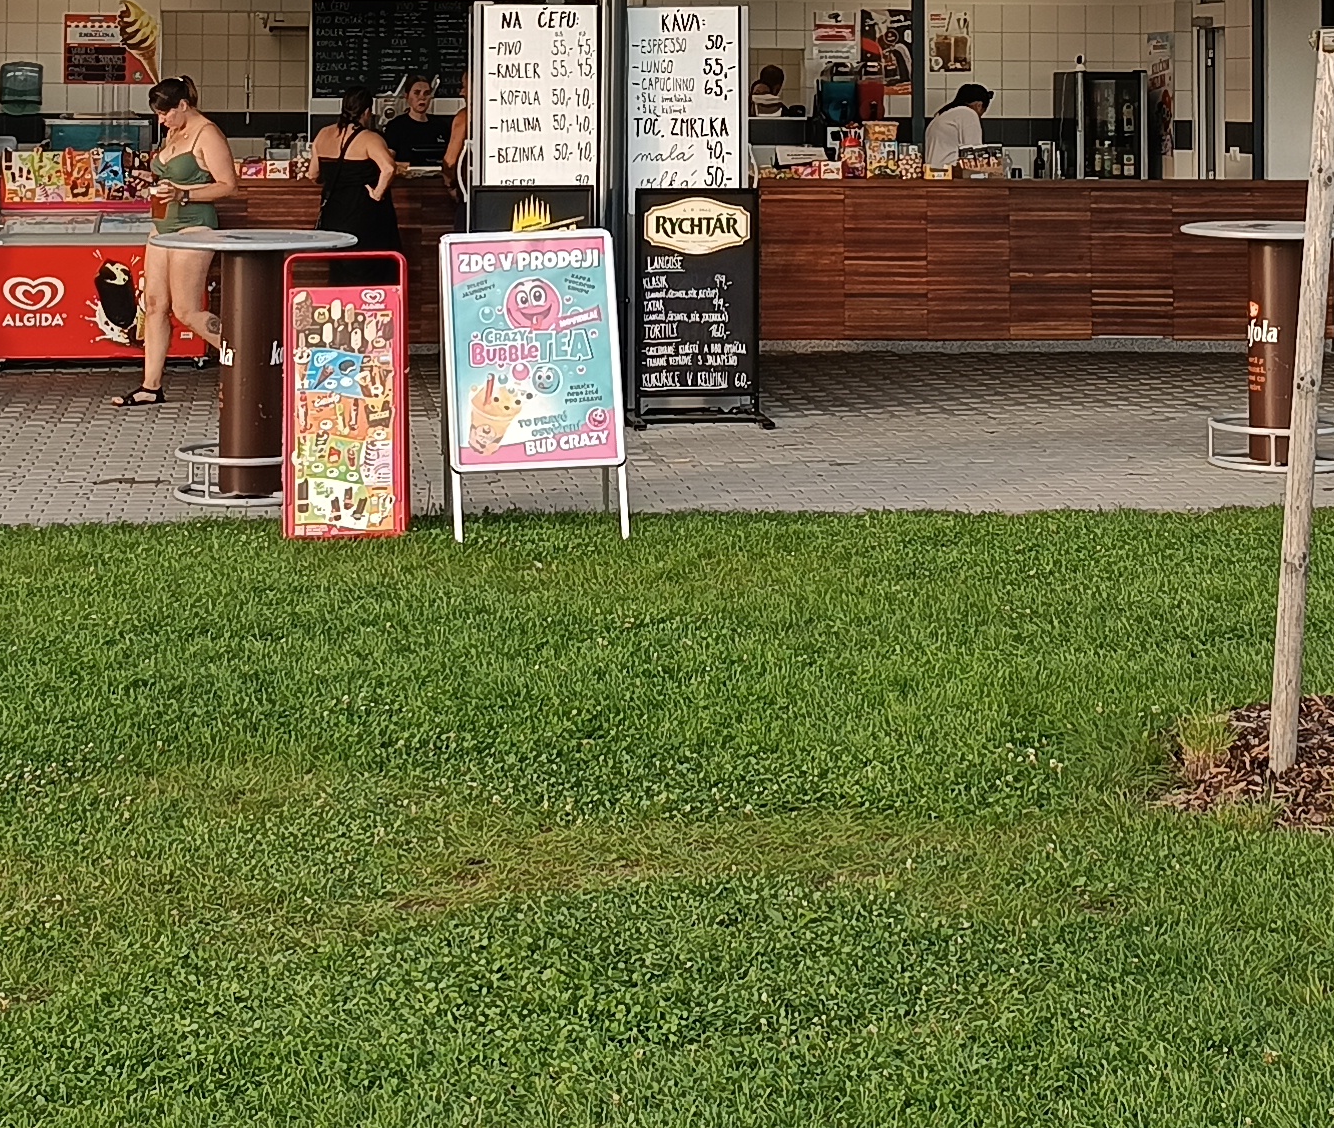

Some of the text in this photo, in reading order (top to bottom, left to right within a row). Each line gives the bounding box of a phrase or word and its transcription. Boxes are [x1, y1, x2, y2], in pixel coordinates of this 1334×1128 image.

[501, 7, 579, 29] NA ČEPU:
[661, 9, 706, 33] KÁVA:
[705, 34, 734, 52] 50,-
[703, 58, 736, 79] 55,-
[704, 79, 734, 101] 65,-
[670, 117, 729, 138] ZMRZKA
[632, 139, 732, 163] malá 40,-
[655, 213, 744, 239] RYCHTÁŘ
[498, 252, 514, 271] V
[2, 313, 64, 327] ALGIDA
[482, 329, 527, 345] CRAZY
[533, 328, 594, 361] TEA
[559, 430, 610, 450] CRAZY
